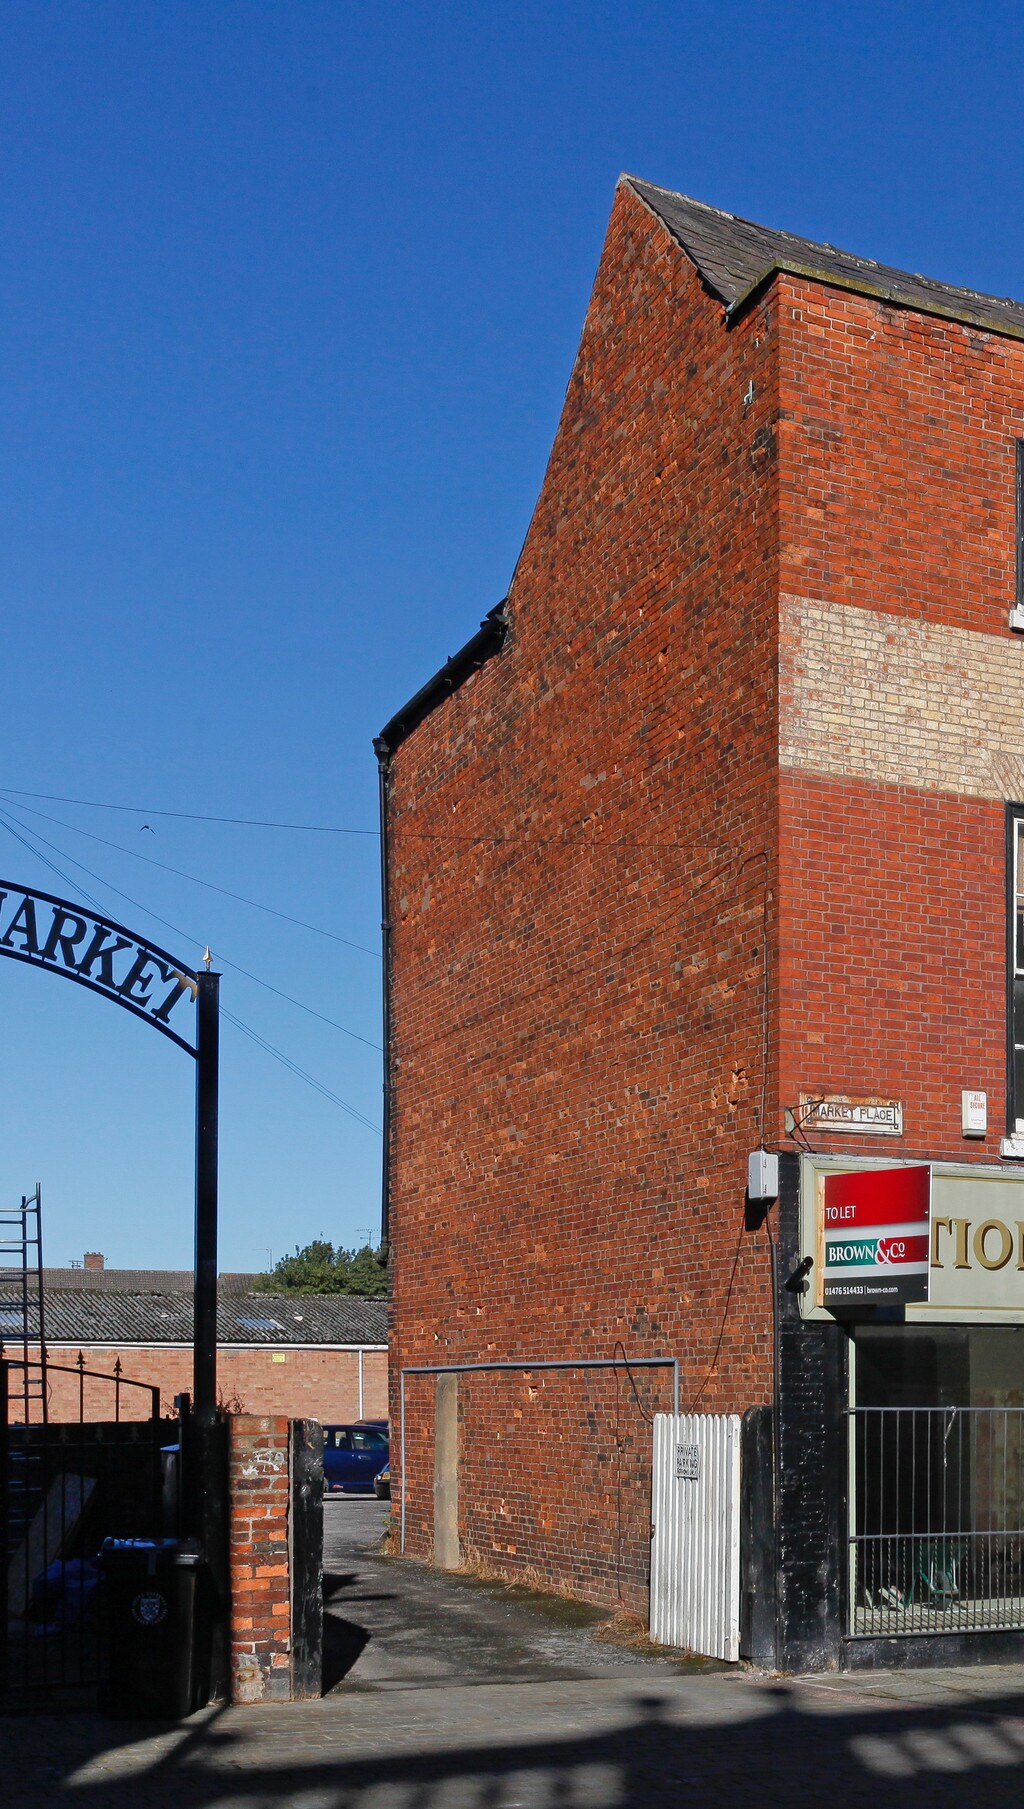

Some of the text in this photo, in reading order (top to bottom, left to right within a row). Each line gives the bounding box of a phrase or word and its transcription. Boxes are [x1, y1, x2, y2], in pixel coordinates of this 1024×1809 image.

[859, 1108, 893, 1121] PLACE
[826, 1205, 857, 1219] TO LET
[824, 1286, 842, 1296] 01476
[843, 1285, 863, 1296] 514433
